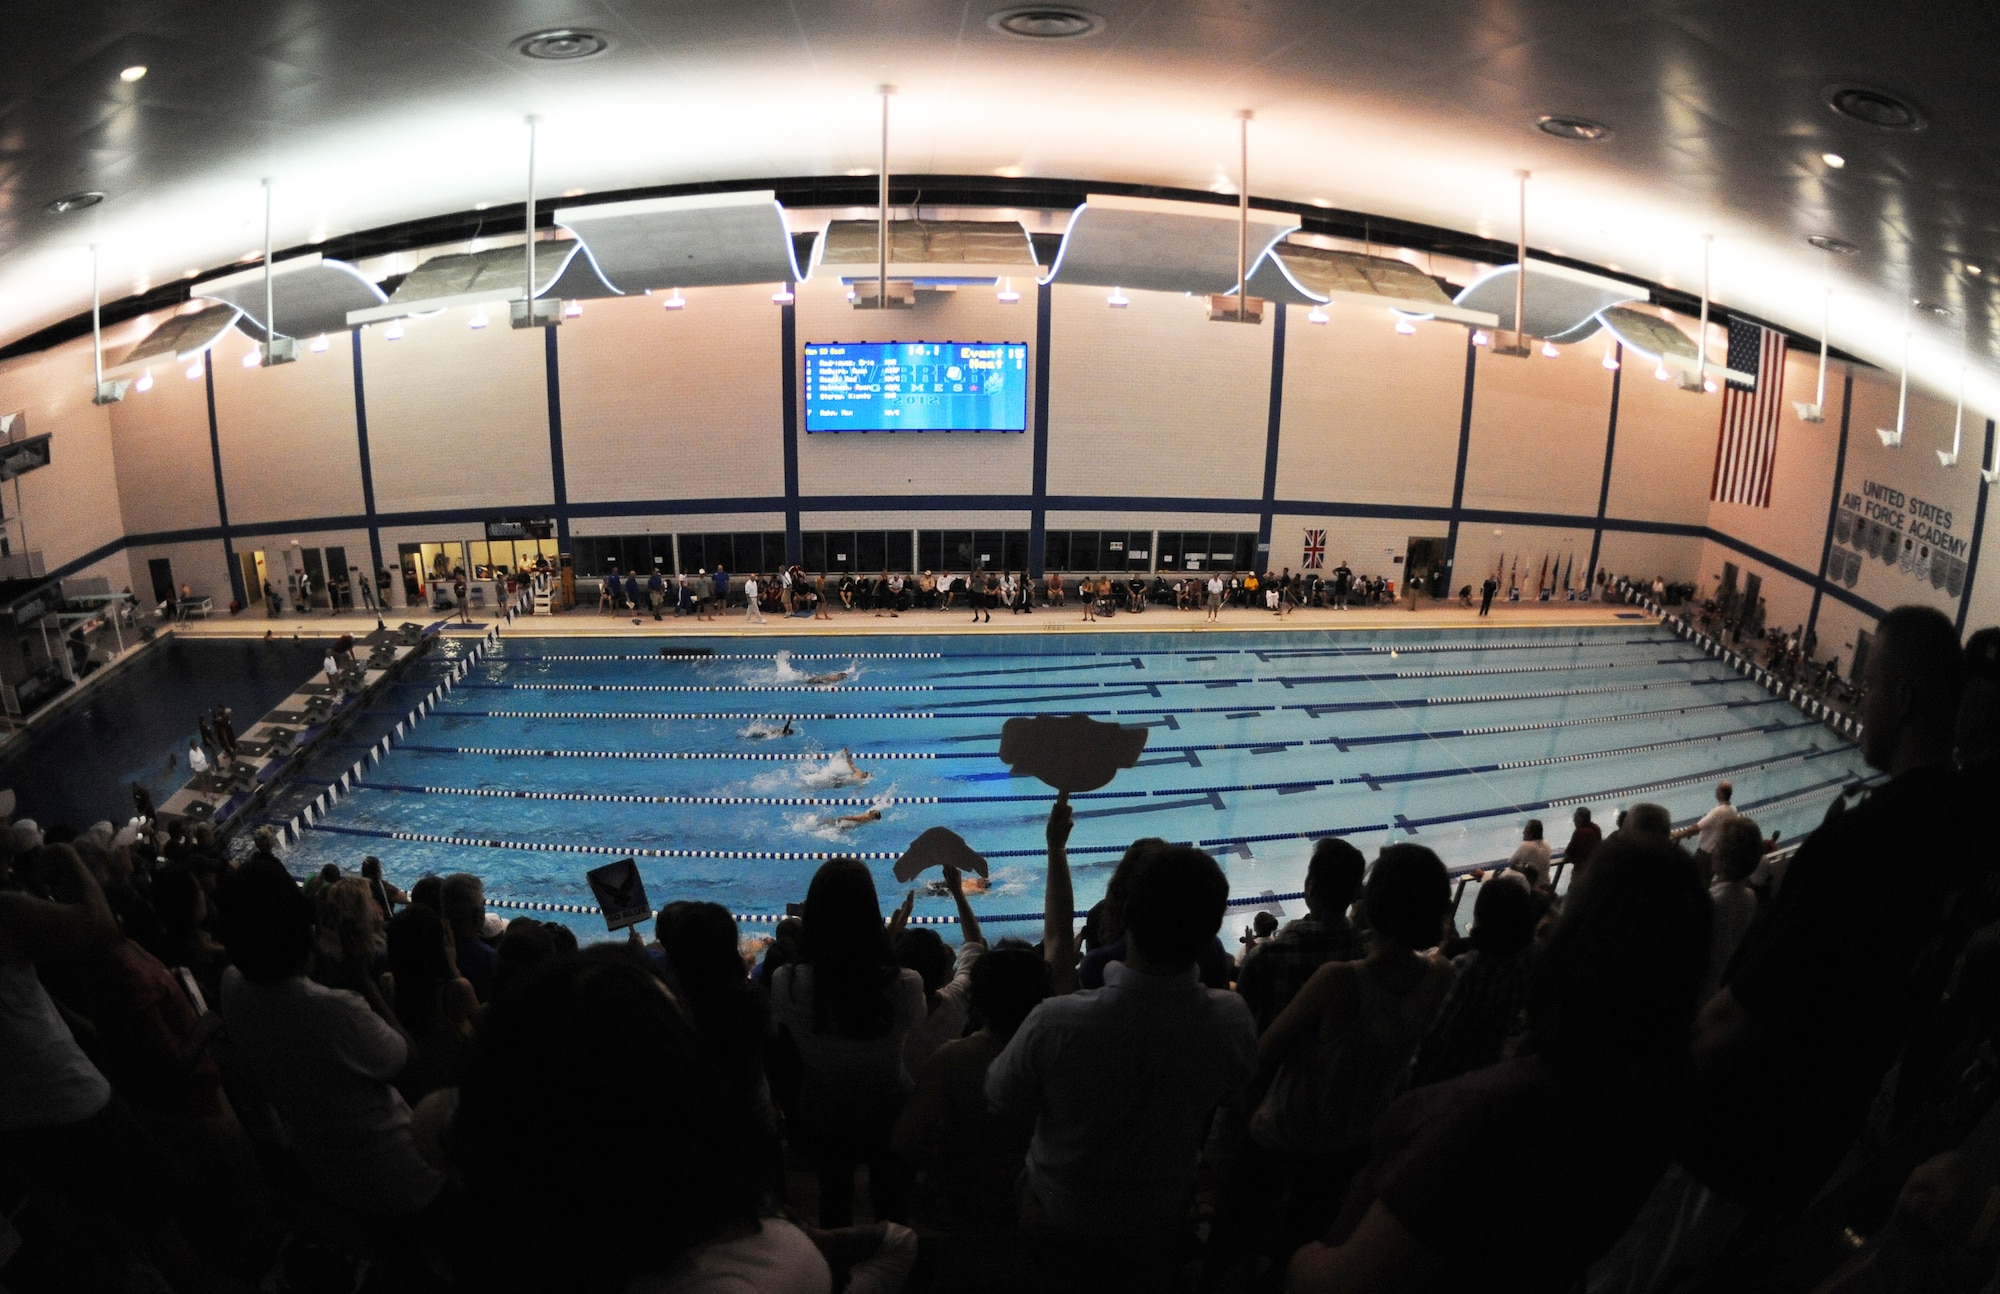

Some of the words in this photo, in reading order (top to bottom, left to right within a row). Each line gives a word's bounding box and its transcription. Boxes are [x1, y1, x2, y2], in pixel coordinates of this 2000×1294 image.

[908, 345, 939, 356] 14.1
[961, 347, 1003, 359] Event
[1008, 348, 1024, 359] 15
[969, 358, 1003, 369] Heat
[1864, 480, 1905, 508] UNITED
[1909, 498, 1953, 529] STATES
[1842, 492, 1862, 512] AIR
[1865, 501, 1905, 530] FORCE
[1909, 520, 1968, 557] ACADEMY
[623, 906, 648, 918] BLUE
